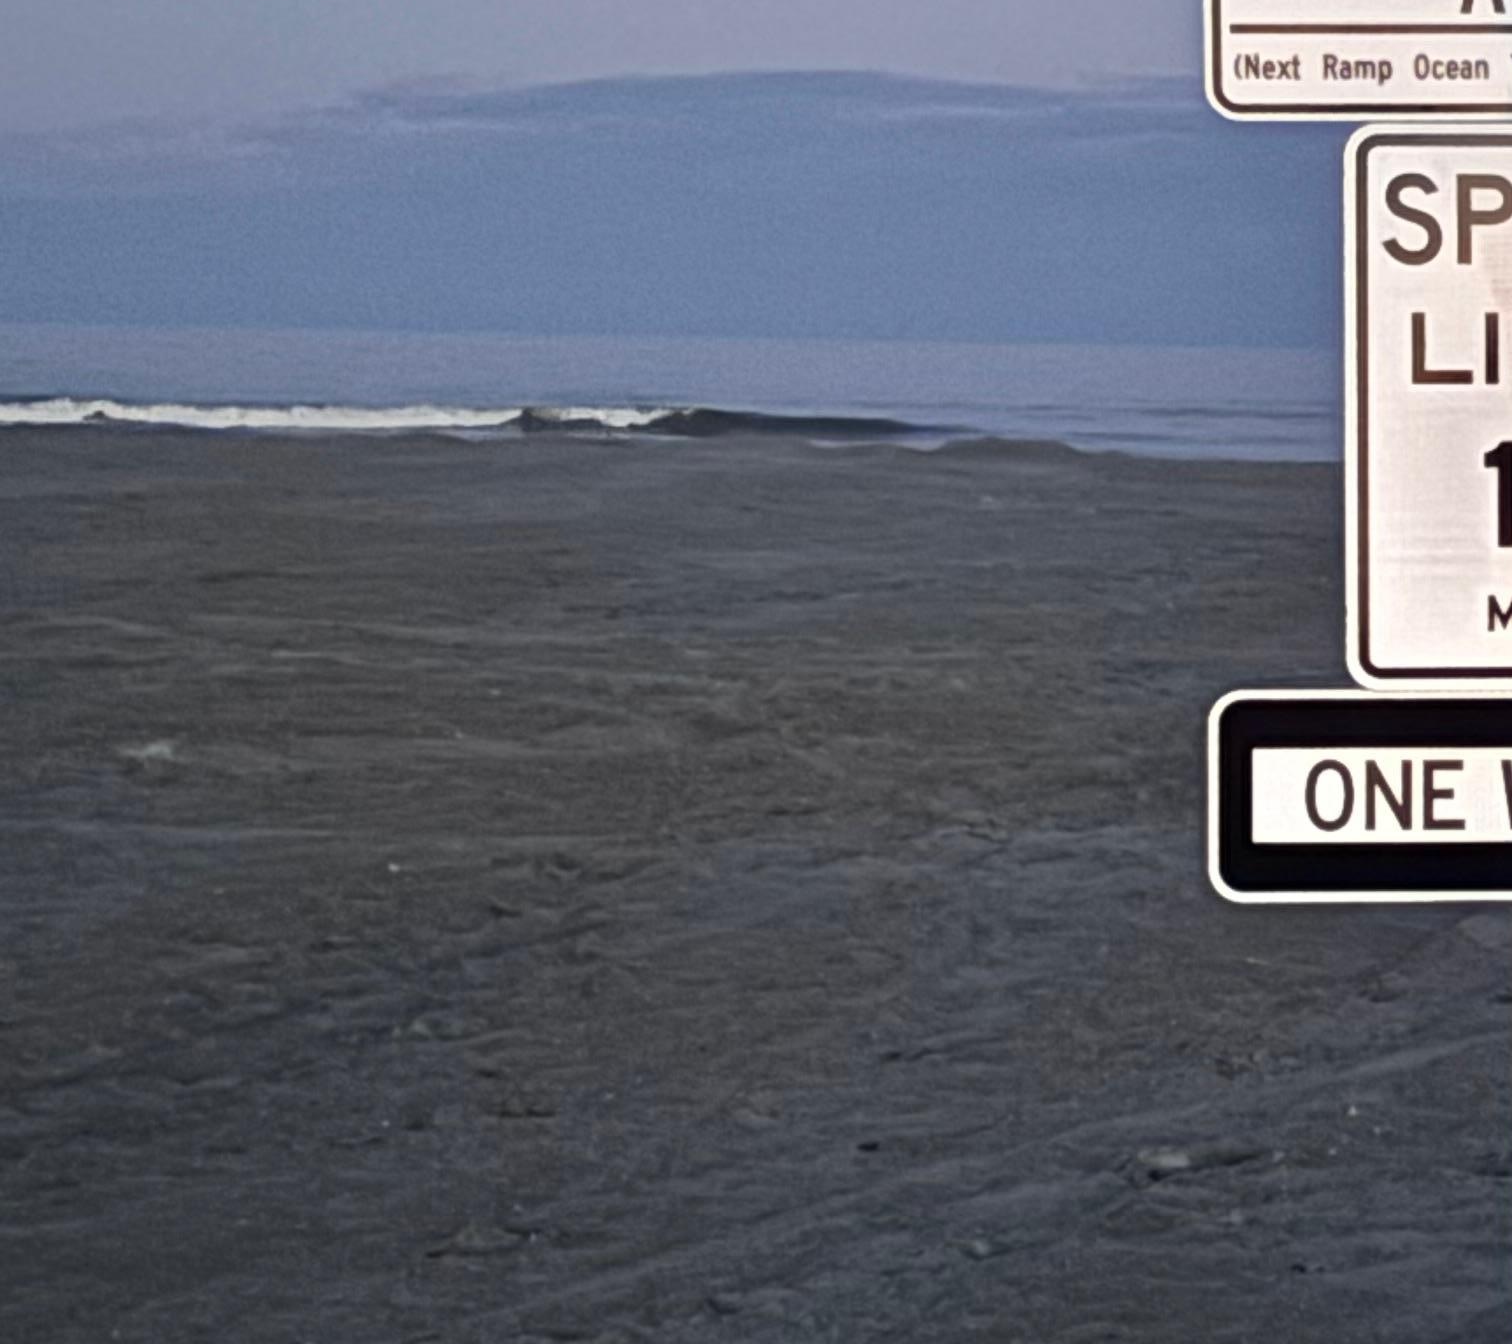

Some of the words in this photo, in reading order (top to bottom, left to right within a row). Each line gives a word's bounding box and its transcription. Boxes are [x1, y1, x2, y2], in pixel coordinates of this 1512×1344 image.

[1233, 53, 1300, 80] (Next
[1323, 54, 1393, 85] Ramp
[1414, 54, 1489, 80] Ocean
[1304, 758, 1464, 833] ONE
